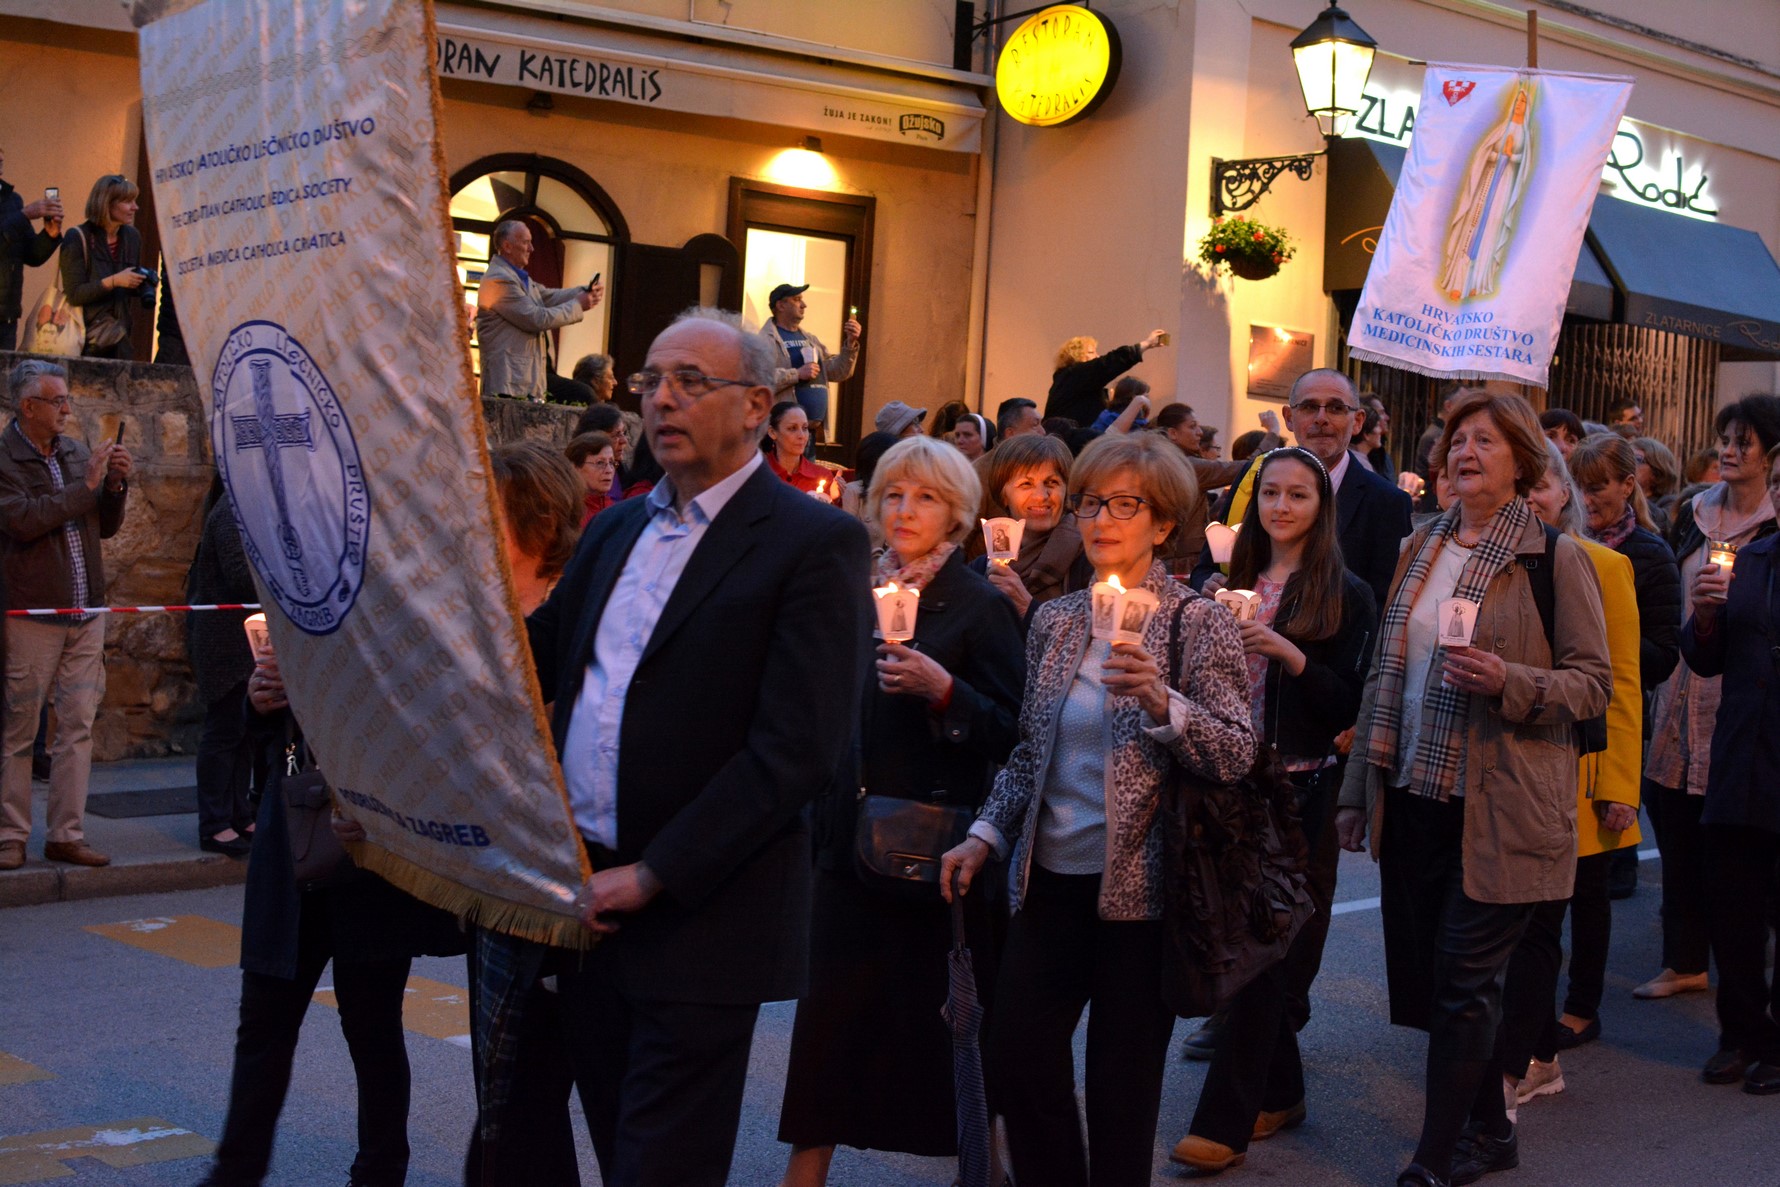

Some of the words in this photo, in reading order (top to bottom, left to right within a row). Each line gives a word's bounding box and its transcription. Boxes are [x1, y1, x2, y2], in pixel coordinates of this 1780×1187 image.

[823, 106, 845, 119] ŽUJA
[847, 111, 857, 121] JE
[859, 113, 892, 127] ZAKON!
[1373, 307, 1463, 342] KATOLIČKO
[1464, 327, 1535, 347] DRUŠTVO
[1421, 303, 1494, 325] HRVATSKO
[1645, 311, 1721, 338] ZLATARNICE
[1363, 323, 1465, 358] MEDICINSKIH
[1466, 344, 1534, 365] SESTARA
